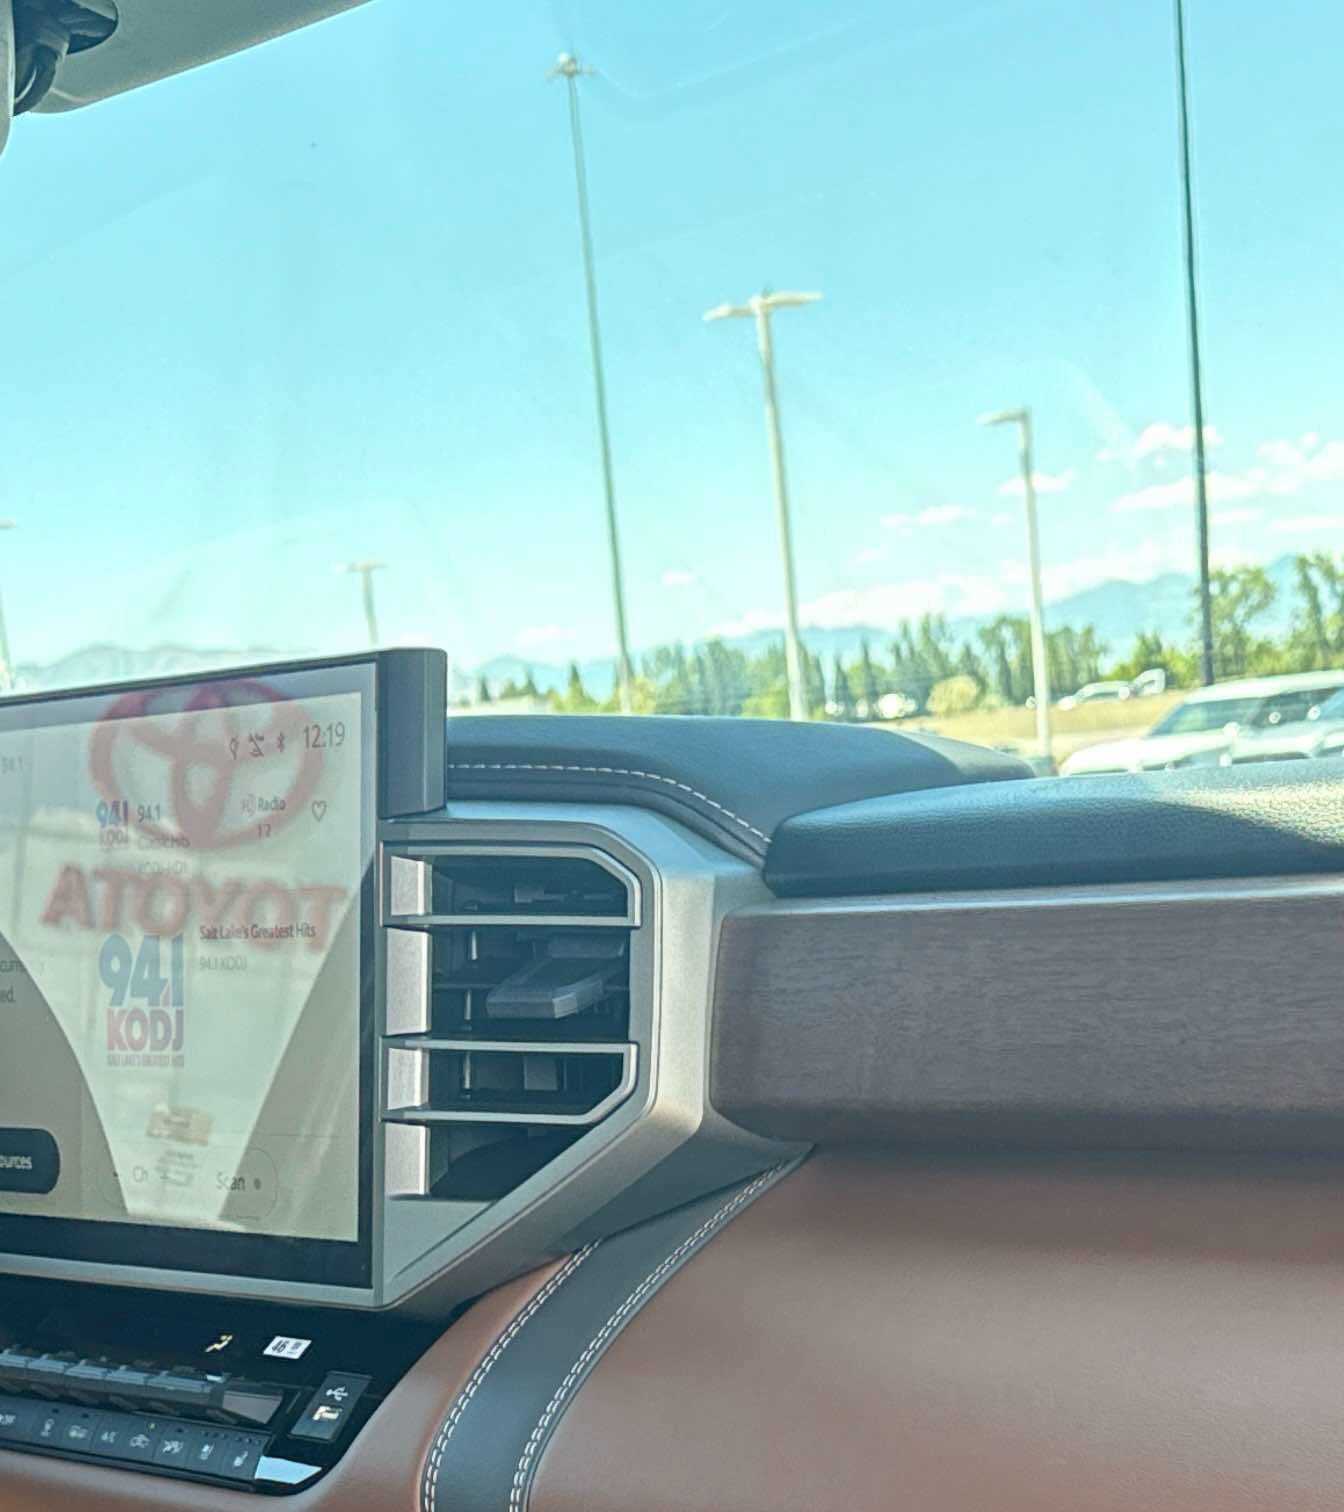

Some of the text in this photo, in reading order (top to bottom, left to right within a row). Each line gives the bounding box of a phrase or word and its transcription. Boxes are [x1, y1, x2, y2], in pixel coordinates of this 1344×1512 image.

[304, 721, 346, 749] 12:19
[250, 923, 294, 939] Greatest
[295, 922, 316, 938] Hits
[100, 933, 184, 1007] 94.1
[106, 1008, 184, 1052] KODJ
[215, 1171, 246, 1191] Scan
